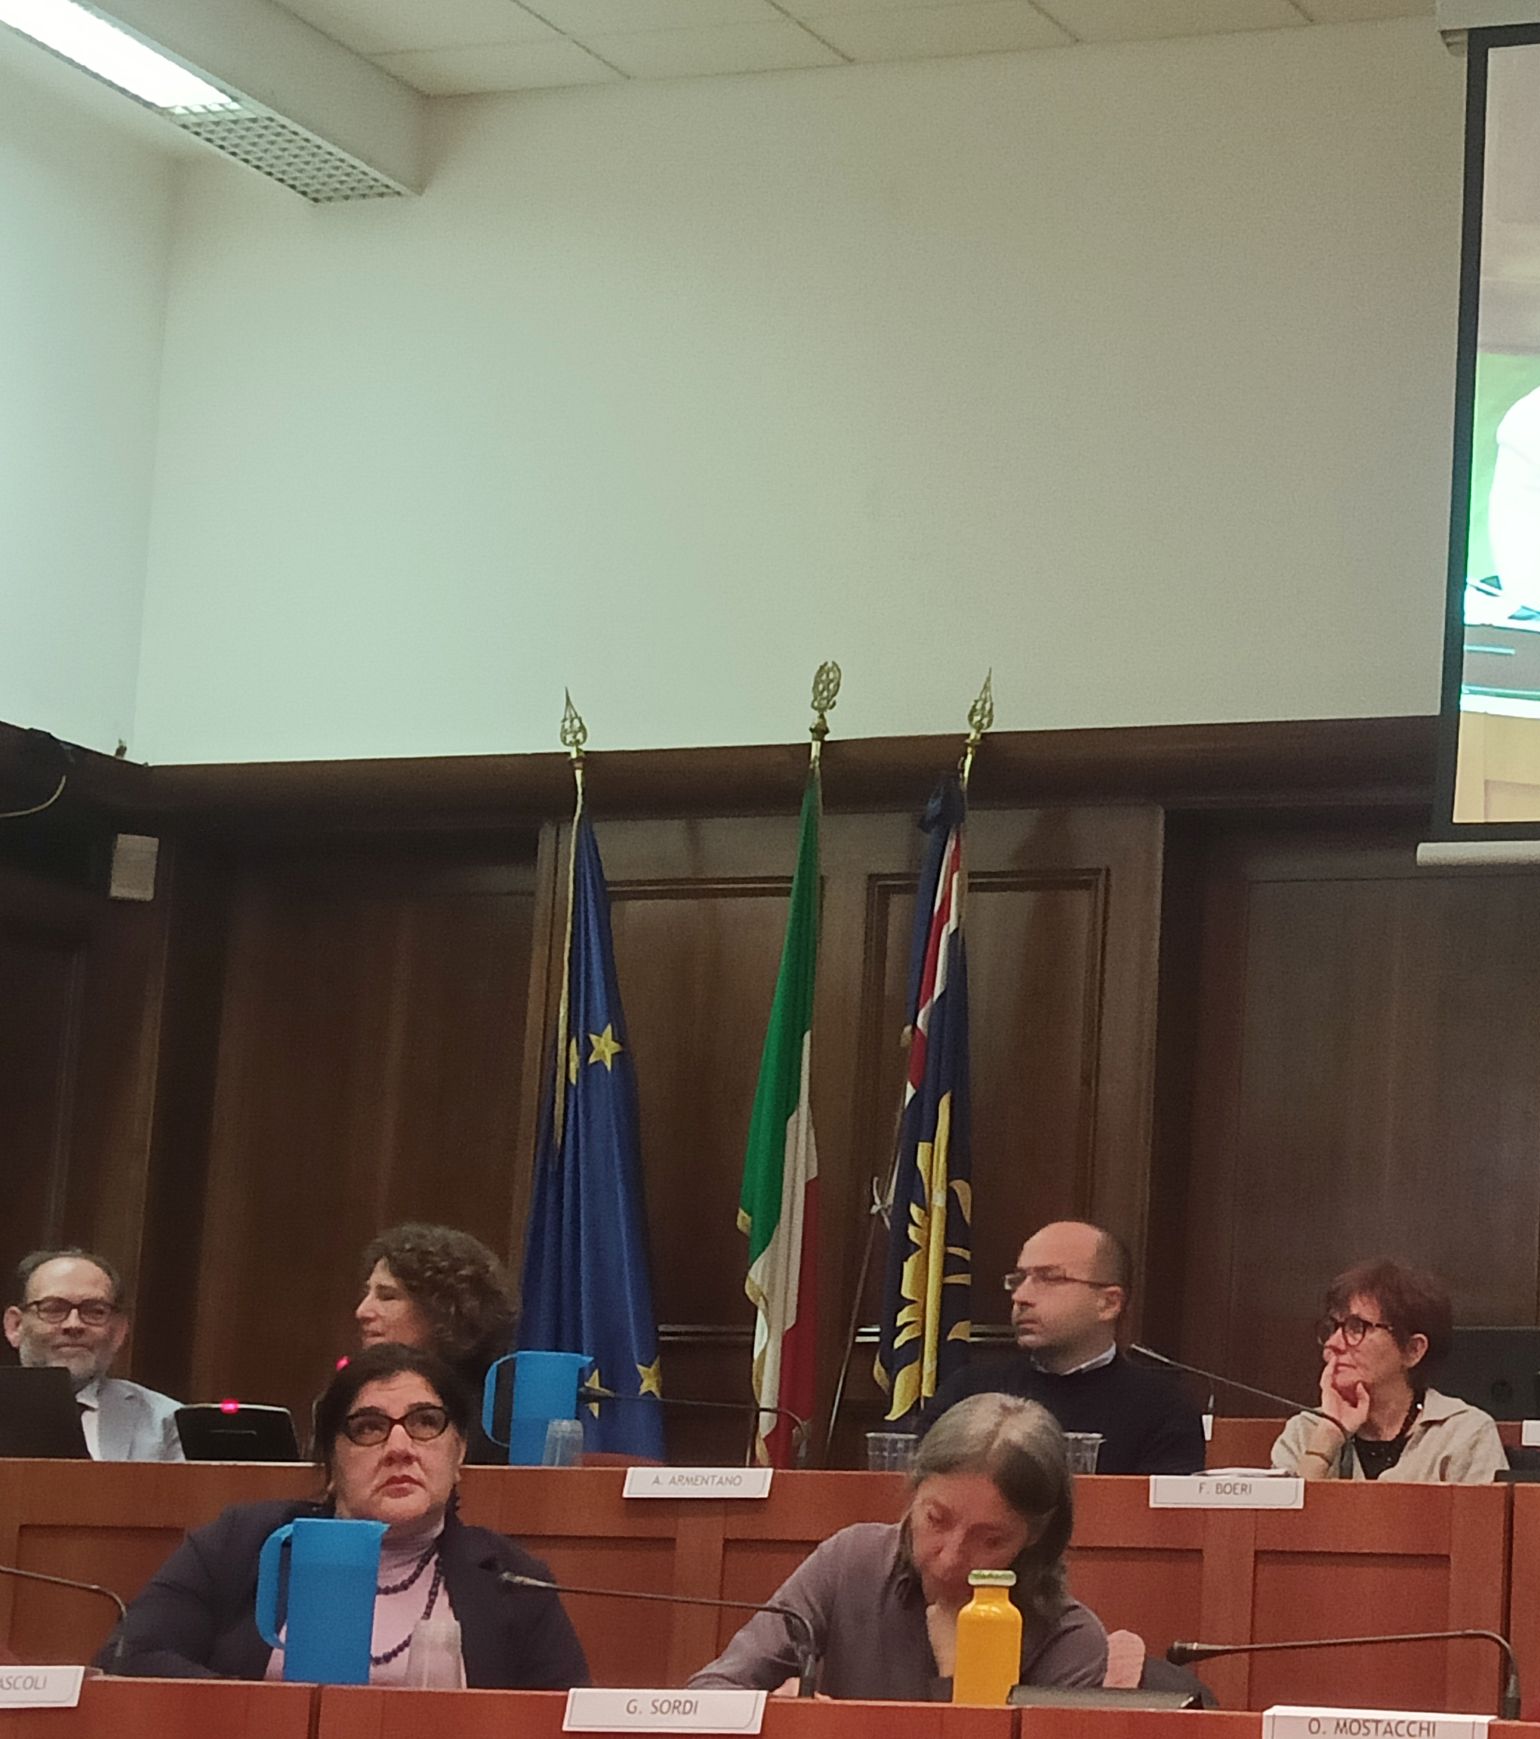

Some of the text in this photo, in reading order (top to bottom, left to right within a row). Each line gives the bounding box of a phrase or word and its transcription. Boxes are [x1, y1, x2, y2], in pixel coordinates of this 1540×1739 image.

[668, 1475, 743, 1487] ARMENTANO
[1198, 1483, 1253, 1496] F. BOERI
[625, 1698, 699, 1716] G. SORDI
[1307, 1718, 1437, 1738] O. MOSTACCHI
